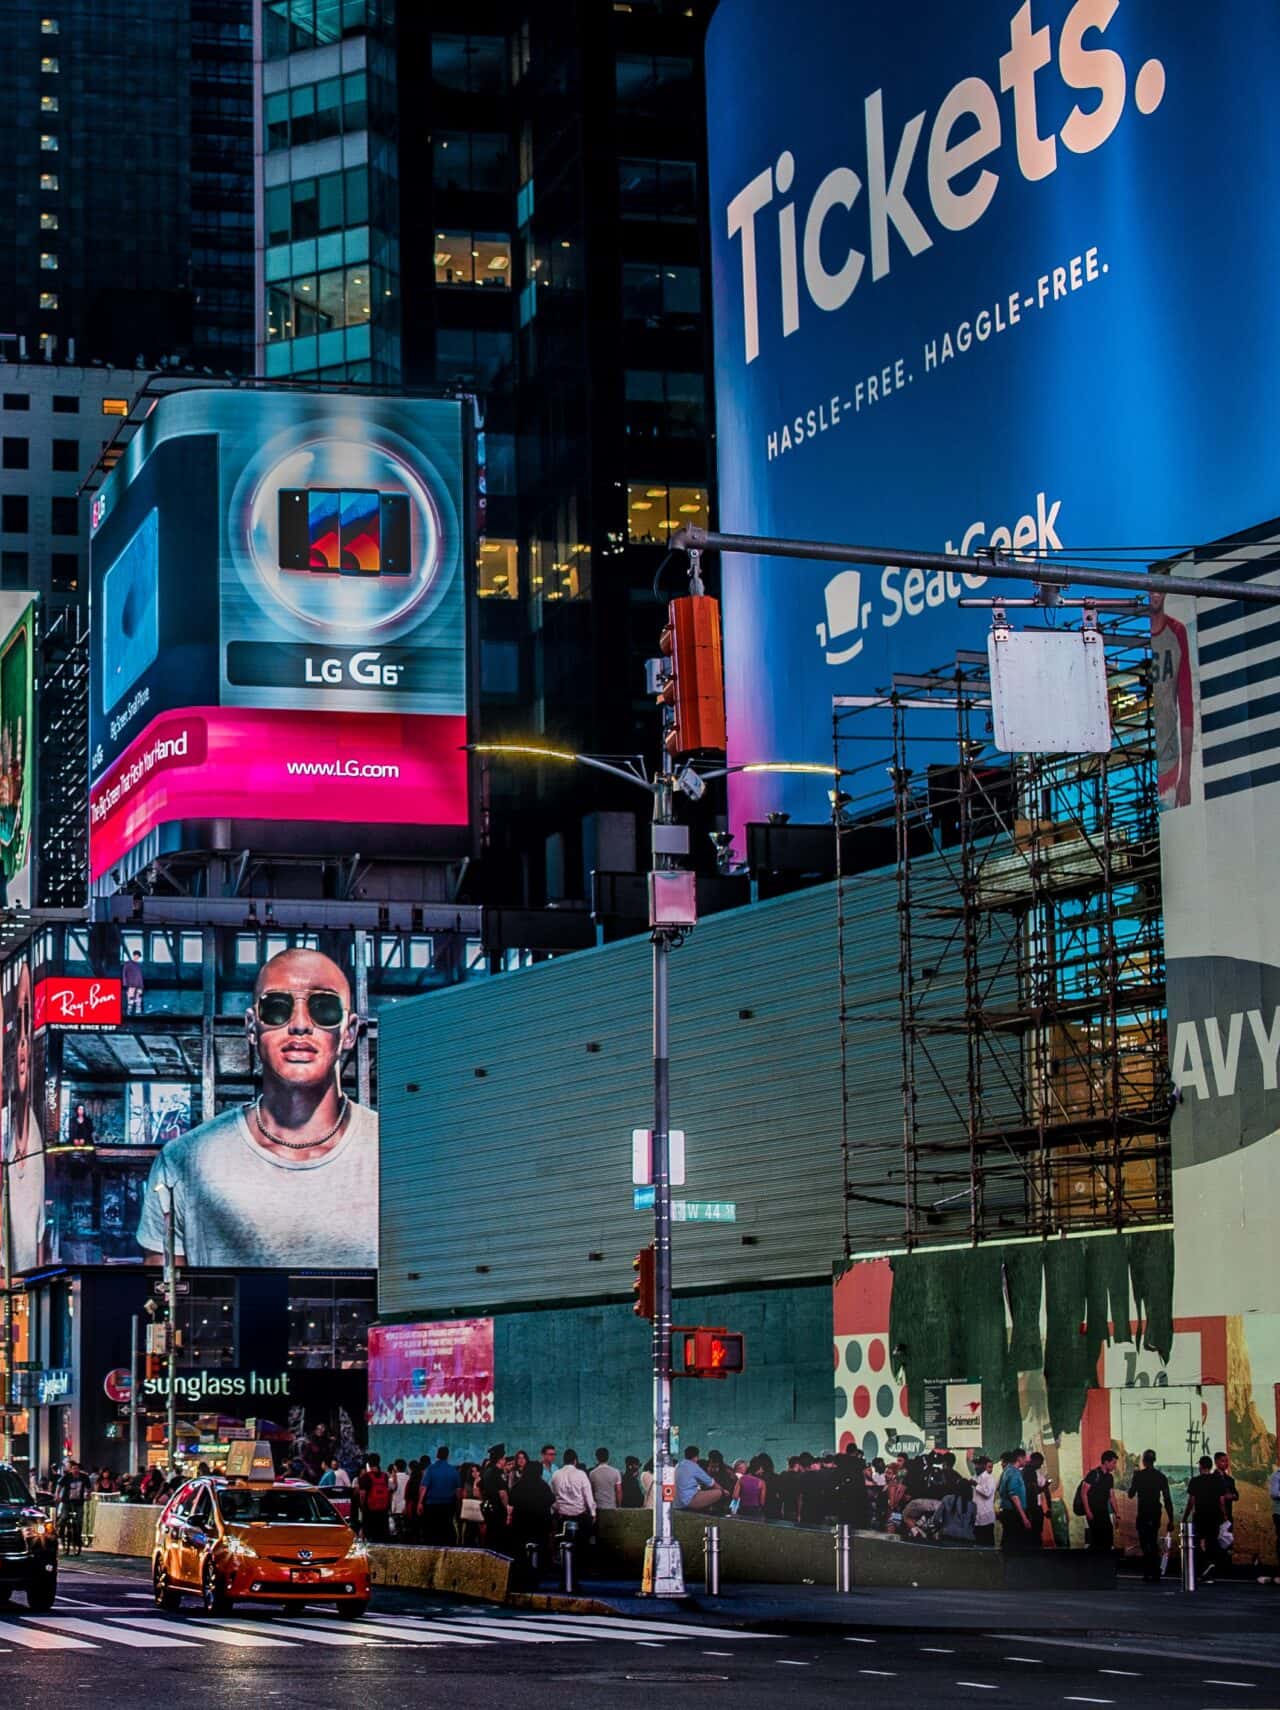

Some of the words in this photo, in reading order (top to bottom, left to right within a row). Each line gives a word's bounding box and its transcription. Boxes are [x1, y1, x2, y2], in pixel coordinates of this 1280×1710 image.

[727, 0, 1166, 364] Tickets.
[767, 358, 913, 461] HASSLE-FREE.
[924, 247, 1110, 372] HAGGLE-FREE.
[881, 492, 1063, 628] SeatGeek
[305, 657, 343, 683] LG
[154, 730, 188, 761] Hand
[286, 759, 399, 779] www.LG.com
[51, 983, 116, 1017] Ray-Ban
[1170, 1004, 1280, 1100] AVY
[687, 1203, 699, 1219] W
[704, 1204, 720, 1219] 44
[144, 1370, 246, 1402] sunglass
[250, 1370, 291, 1396] hut
[903, 1441, 920, 1452] NAVY
